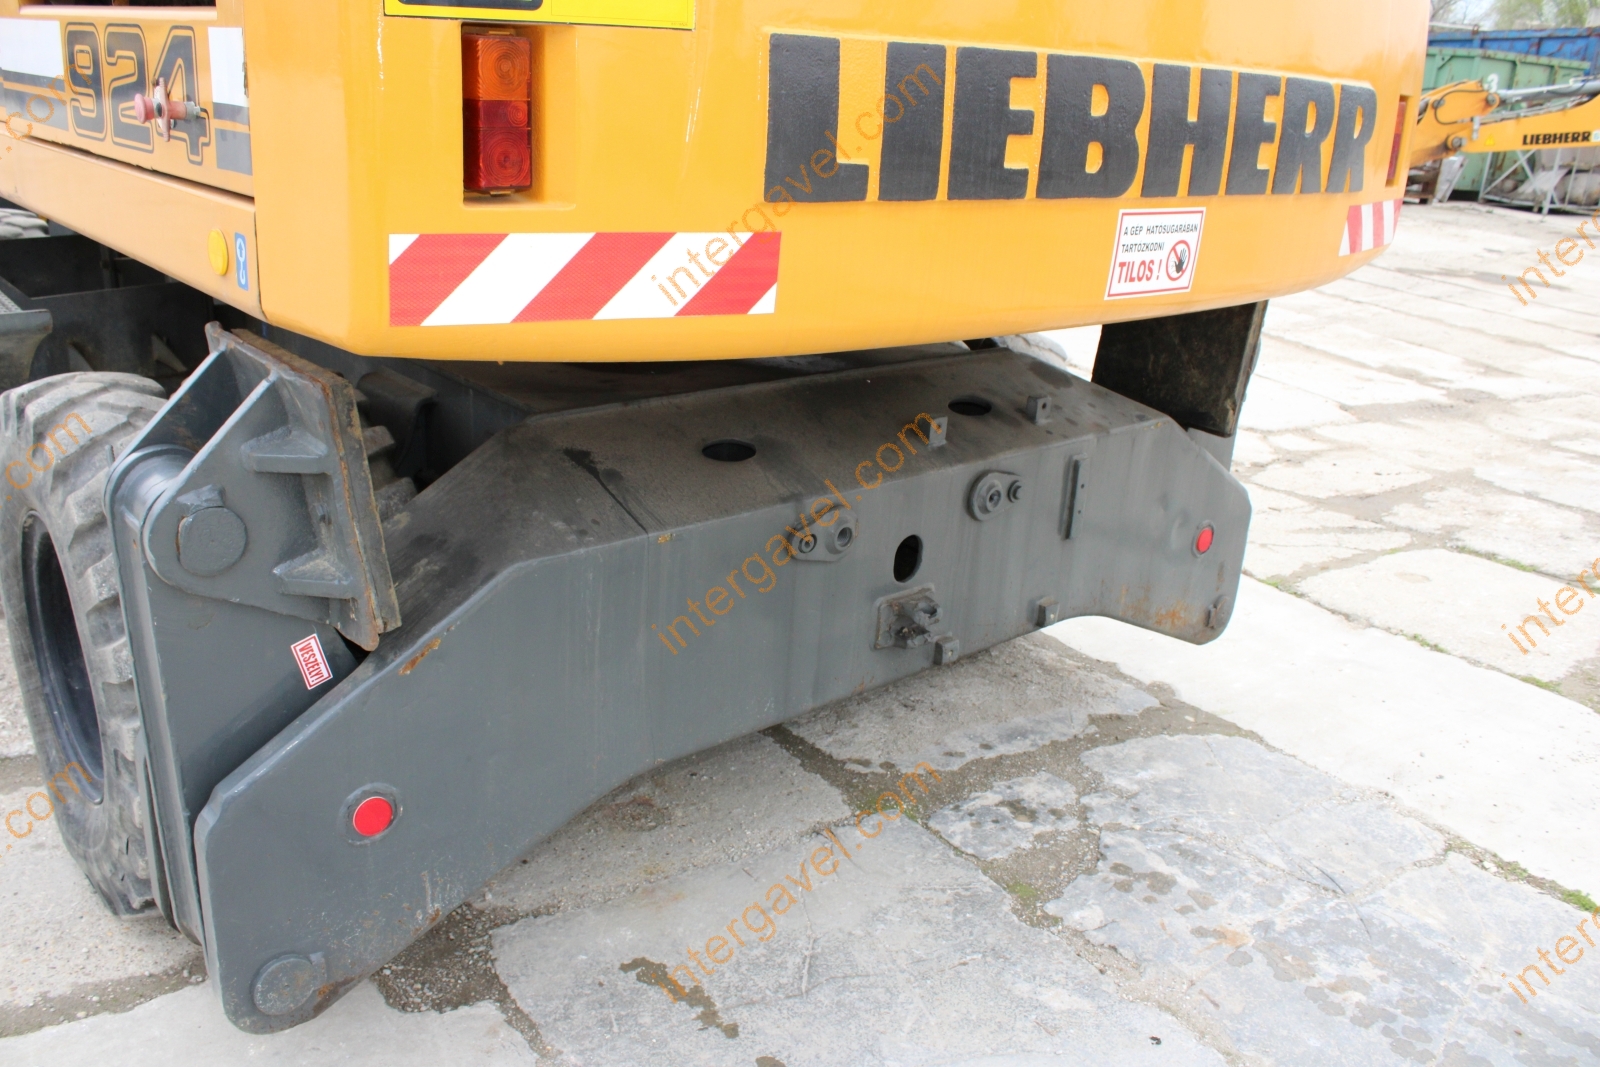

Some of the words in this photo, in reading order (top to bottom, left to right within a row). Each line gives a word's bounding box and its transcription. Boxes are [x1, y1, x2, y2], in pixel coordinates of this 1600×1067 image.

[65, 22, 211, 166] 924
[764, 33, 1377, 202] LIEBHERR
[1522, 131, 1591, 146] LIEBHERR
[1124, 227, 1128, 235] A
[1130, 224, 1143, 235] GÉP
[1121, 240, 1165, 253] TARTÓZKODNI
[299, 642, 324, 682] VESZÉLY!
